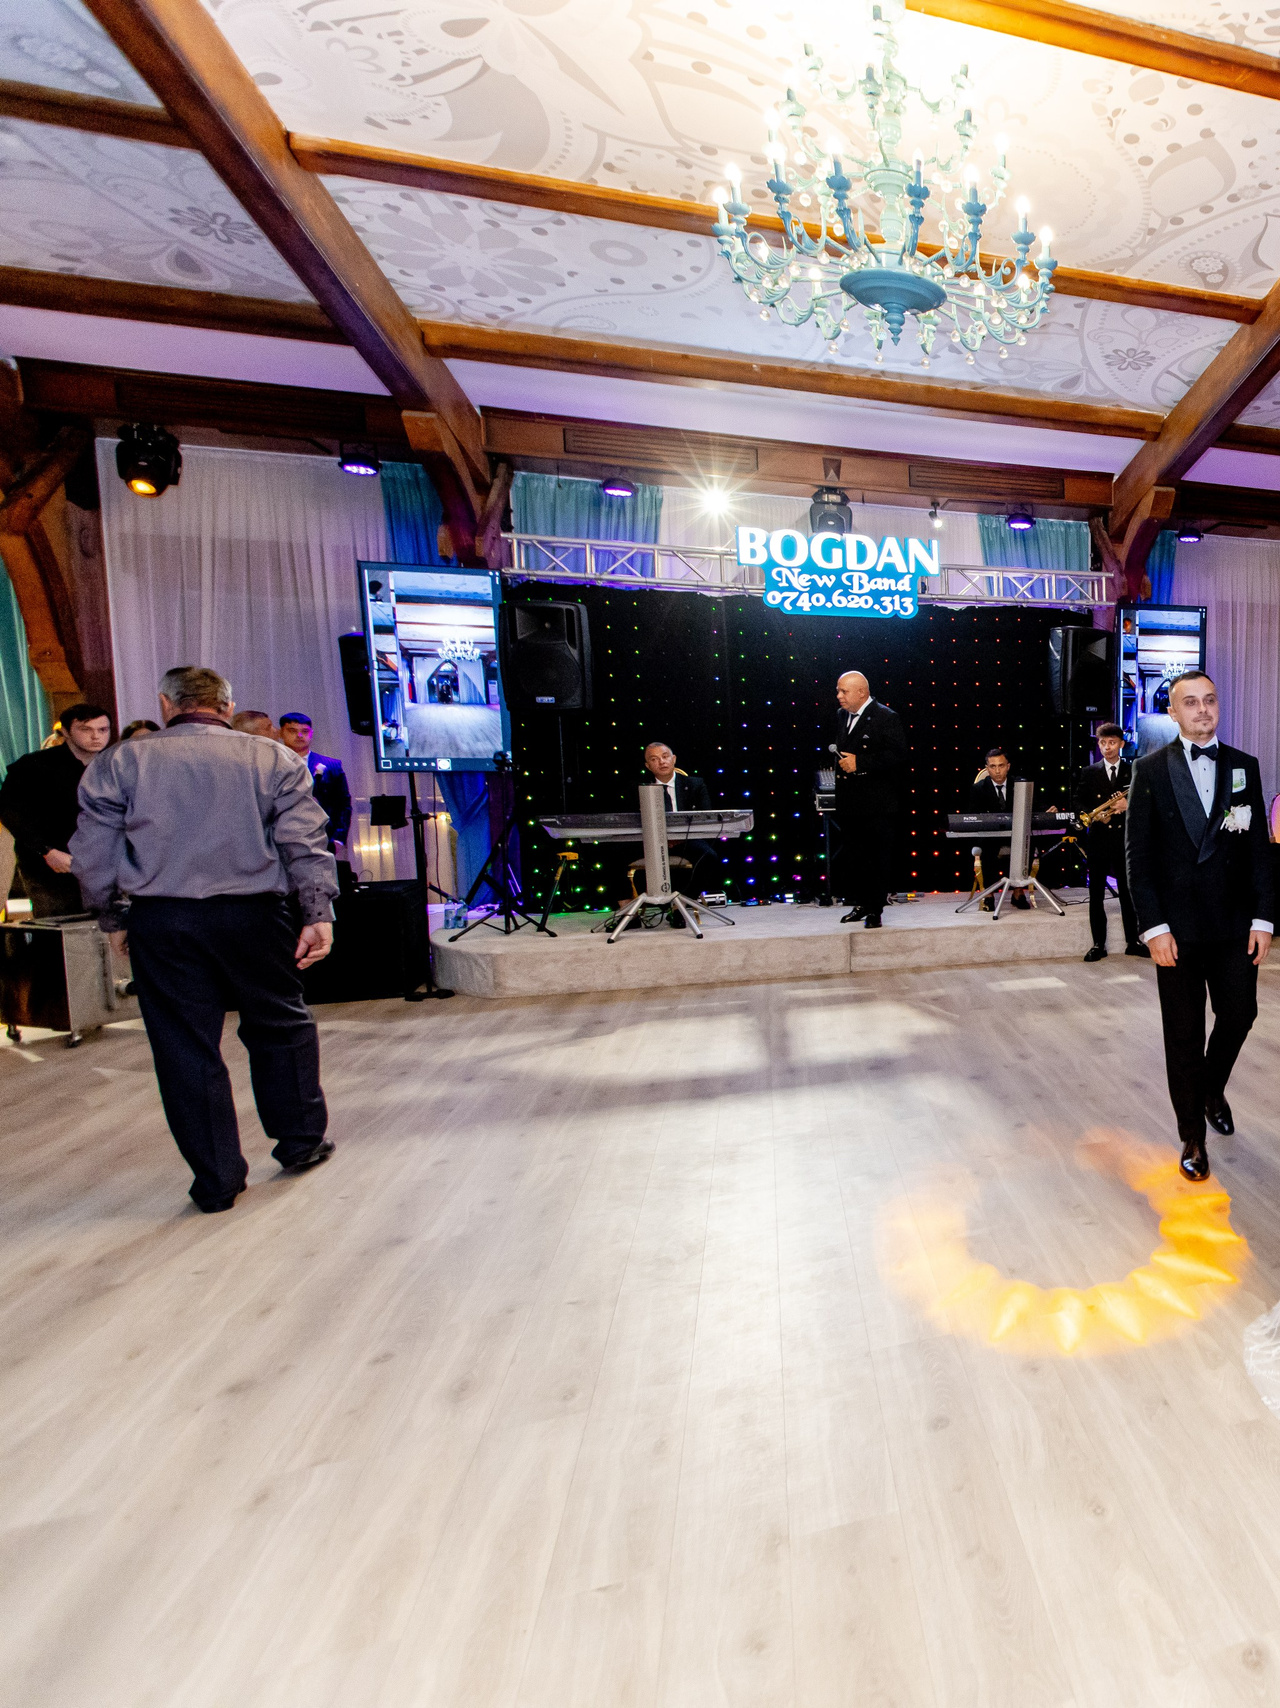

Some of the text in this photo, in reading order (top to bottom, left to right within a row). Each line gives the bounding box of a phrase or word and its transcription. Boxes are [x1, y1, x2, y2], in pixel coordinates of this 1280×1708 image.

[736, 526, 939, 575] BOGDAN
[771, 567, 912, 595] New Band
[766, 589, 914, 615] 0740.620.313
[1055, 812, 1075, 820] KORG
